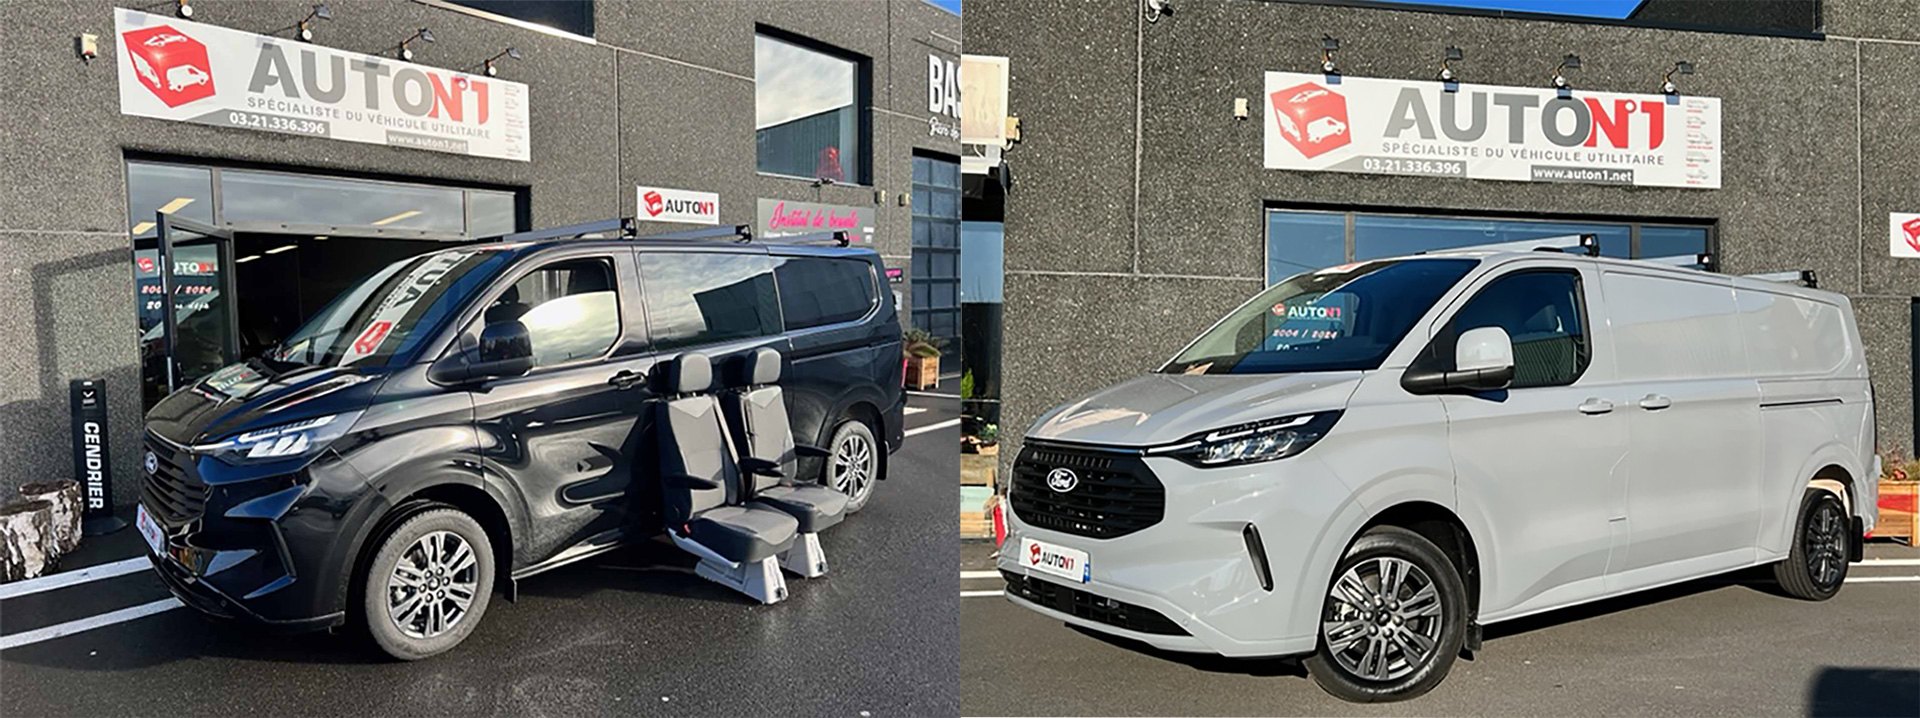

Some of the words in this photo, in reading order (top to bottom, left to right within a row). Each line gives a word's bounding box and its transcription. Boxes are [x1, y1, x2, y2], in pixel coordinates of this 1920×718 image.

[229, 111, 326, 135] 03.21.336.396
[247, 95, 341, 119] SPÉCIALISTE
[345, 110, 363, 122] DU
[368, 112, 428, 131] VÉHICULE
[431, 120, 491, 139] UTILITAIRE
[387, 133, 469, 152] www.auton1.net
[1382, 142, 1479, 157] SPÉCIALISTE
[1485, 147, 1504, 158] DU
[1510, 149, 1581, 162] VÉHICULE
[1587, 153, 1665, 166] UTILITAIRE
[1363, 158, 1462, 175] 03.21.336.396
[1533, 167, 1633, 183] www.auton1.net
[83, 421, 104, 510] CENDRIER
